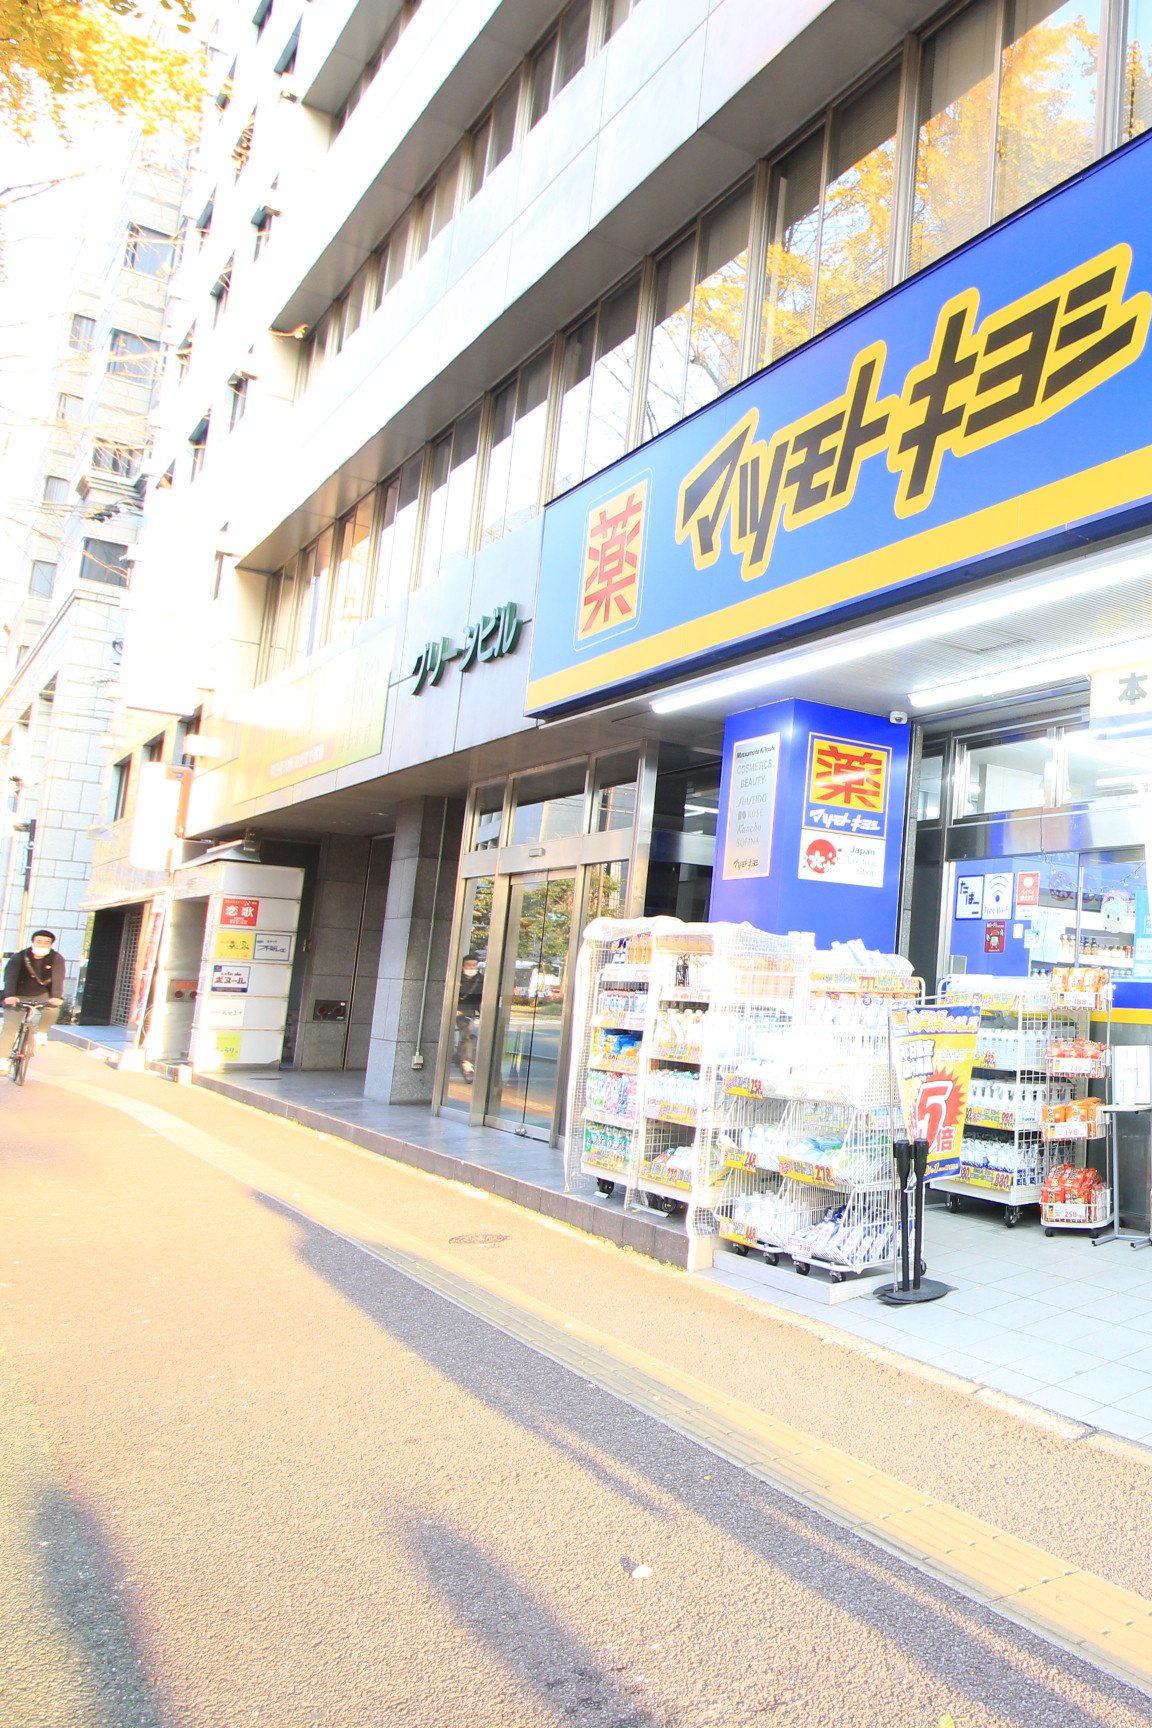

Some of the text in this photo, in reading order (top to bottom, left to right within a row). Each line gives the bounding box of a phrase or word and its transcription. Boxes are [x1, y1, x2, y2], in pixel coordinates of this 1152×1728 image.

[676, 243, 1152, 580] マツモトキヨシ
[583, 492, 643, 632] 薬
[411, 602, 524, 696] クリーンビル
[737, 760, 772, 774] COSMETICS
[740, 775, 766, 788] BEAUTY
[815, 745, 884, 810] 薬
